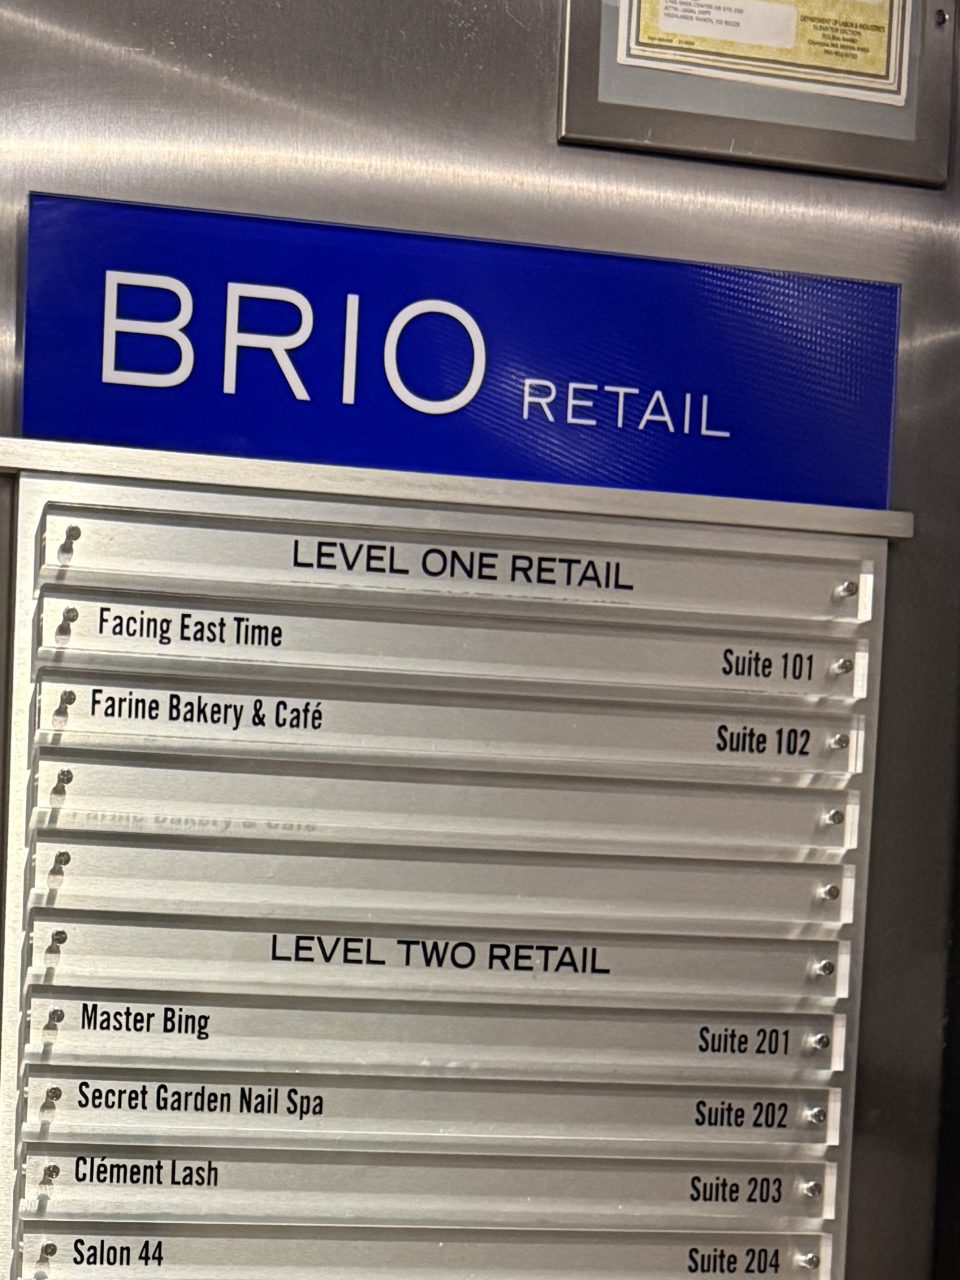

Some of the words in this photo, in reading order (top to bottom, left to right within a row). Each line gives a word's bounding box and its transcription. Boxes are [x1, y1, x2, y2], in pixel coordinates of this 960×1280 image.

[101, 268, 487, 415] BRIO
[522, 378, 731, 439] RETAIL
[292, 539, 410, 575] LEVEL
[421, 548, 499, 582] ONE
[510, 554, 635, 591] RETAIL
[98, 606, 172, 645] Facing
[180, 612, 227, 644] East
[233, 617, 283, 648] Time
[721, 648, 773, 679] Suite
[781, 653, 815, 681] 101
[90, 688, 160, 721] Farine
[168, 693, 244, 731] Bakery
[252, 699, 267, 727] &
[274, 701, 324, 730] Café
[716, 724, 767, 755] Suite
[775, 728, 811, 756] 102
[271, 934, 386, 965] LEVEL
[397, 939, 477, 969] TWO
[488, 943, 611, 975] RETAIL
[81, 1003, 155, 1033] Master
[163, 1007, 210, 1040] Bing
[698, 1026, 749, 1055] Suite
[755, 1028, 790, 1055] 201
[77, 1081, 148, 1111] Secret
[156, 1084, 232, 1113] Garden
[239, 1086, 279, 1115] Nail
[286, 1088, 324, 1120] Spa
[694, 1100, 745, 1128] Suite
[752, 1102, 788, 1129] 202
[74, 1156, 164, 1185] Clément
[170, 1160, 219, 1187] Lash
[689, 1175, 740, 1203] Suite
[747, 1177, 783, 1204] 203
[72, 1238, 131, 1266] Salon
[138, 1240, 164, 1266] 44
[688, 1247, 738, 1274] Suite
[744, 1248, 780, 1274] 204
